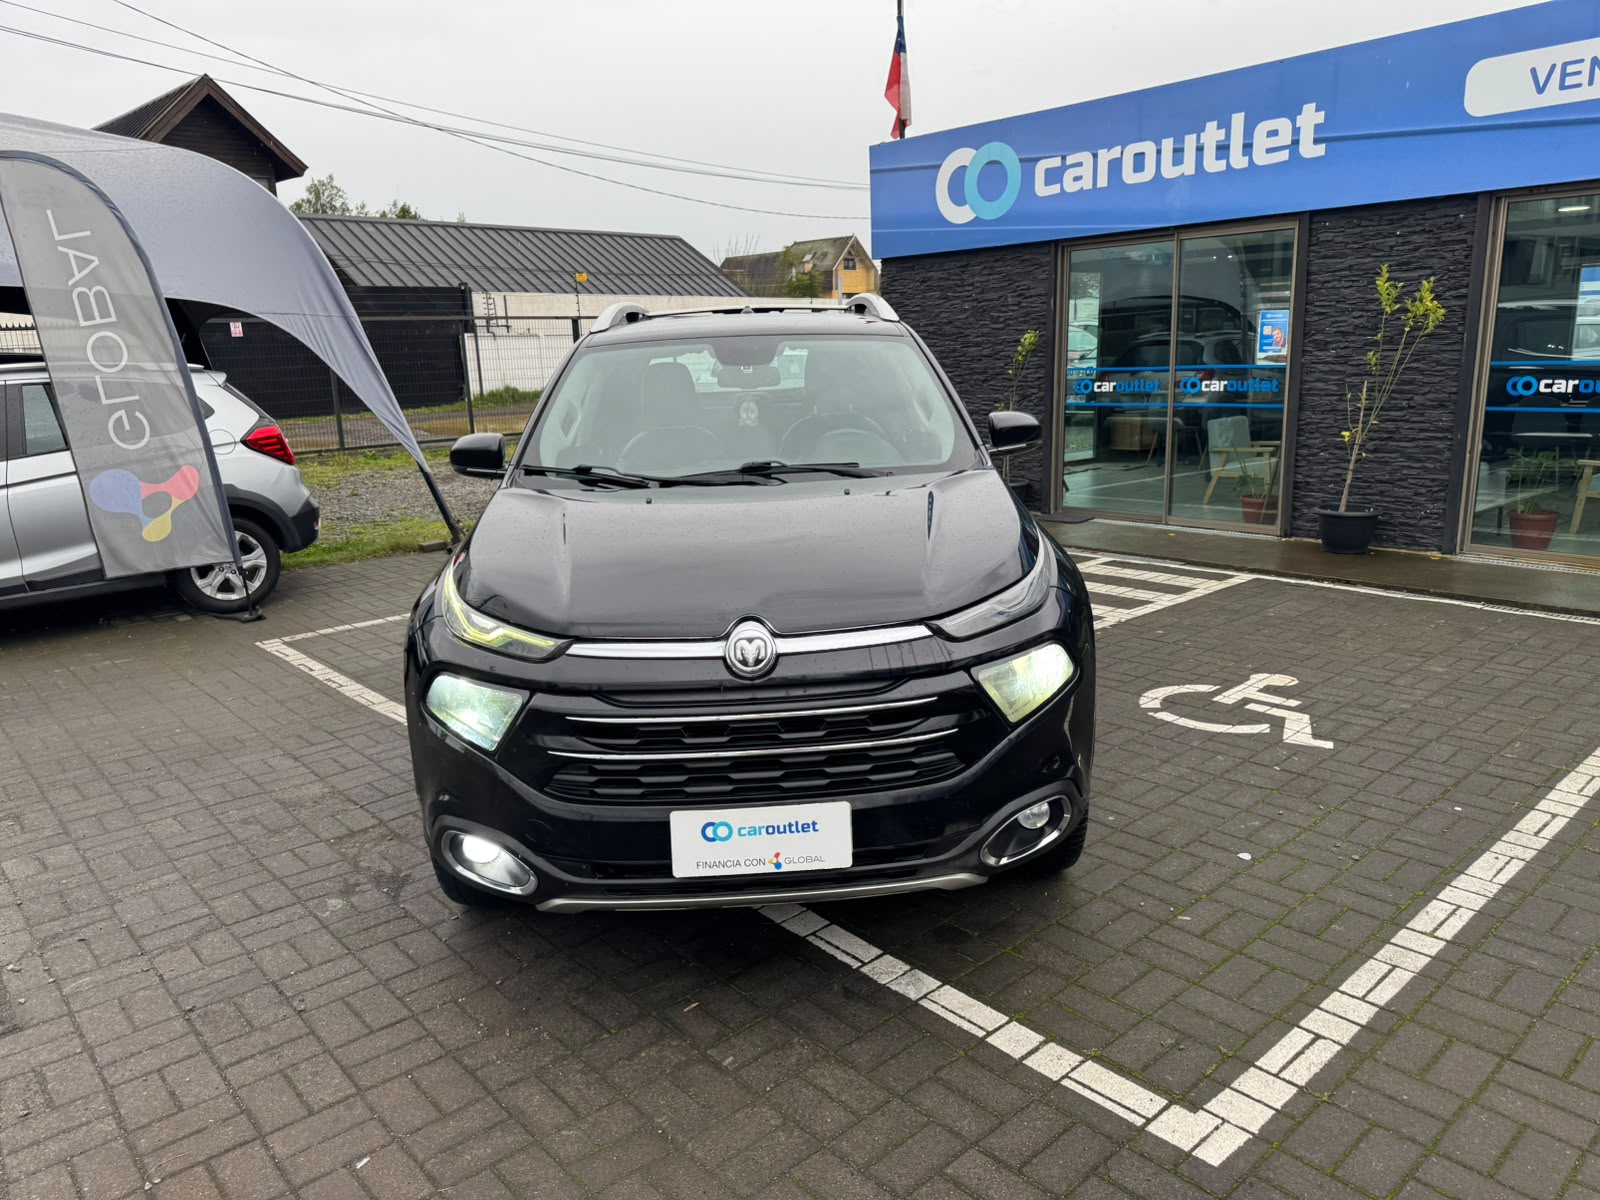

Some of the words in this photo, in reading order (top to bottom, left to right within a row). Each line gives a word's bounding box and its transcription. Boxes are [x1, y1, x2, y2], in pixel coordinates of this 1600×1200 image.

[1034, 102, 1326, 197] caroutlet
[46, 209, 150, 450] GLOBAL
[1093, 379, 1160, 393] caroutlet
[1201, 377, 1279, 393] caroutlet
[1539, 378, 1600, 394] caro
[737, 820, 819, 837] caroutlet
[696, 859, 742, 869] FINANCIA
[743, 857, 766, 867] CON
[784, 855, 825, 864] GLOBAL
